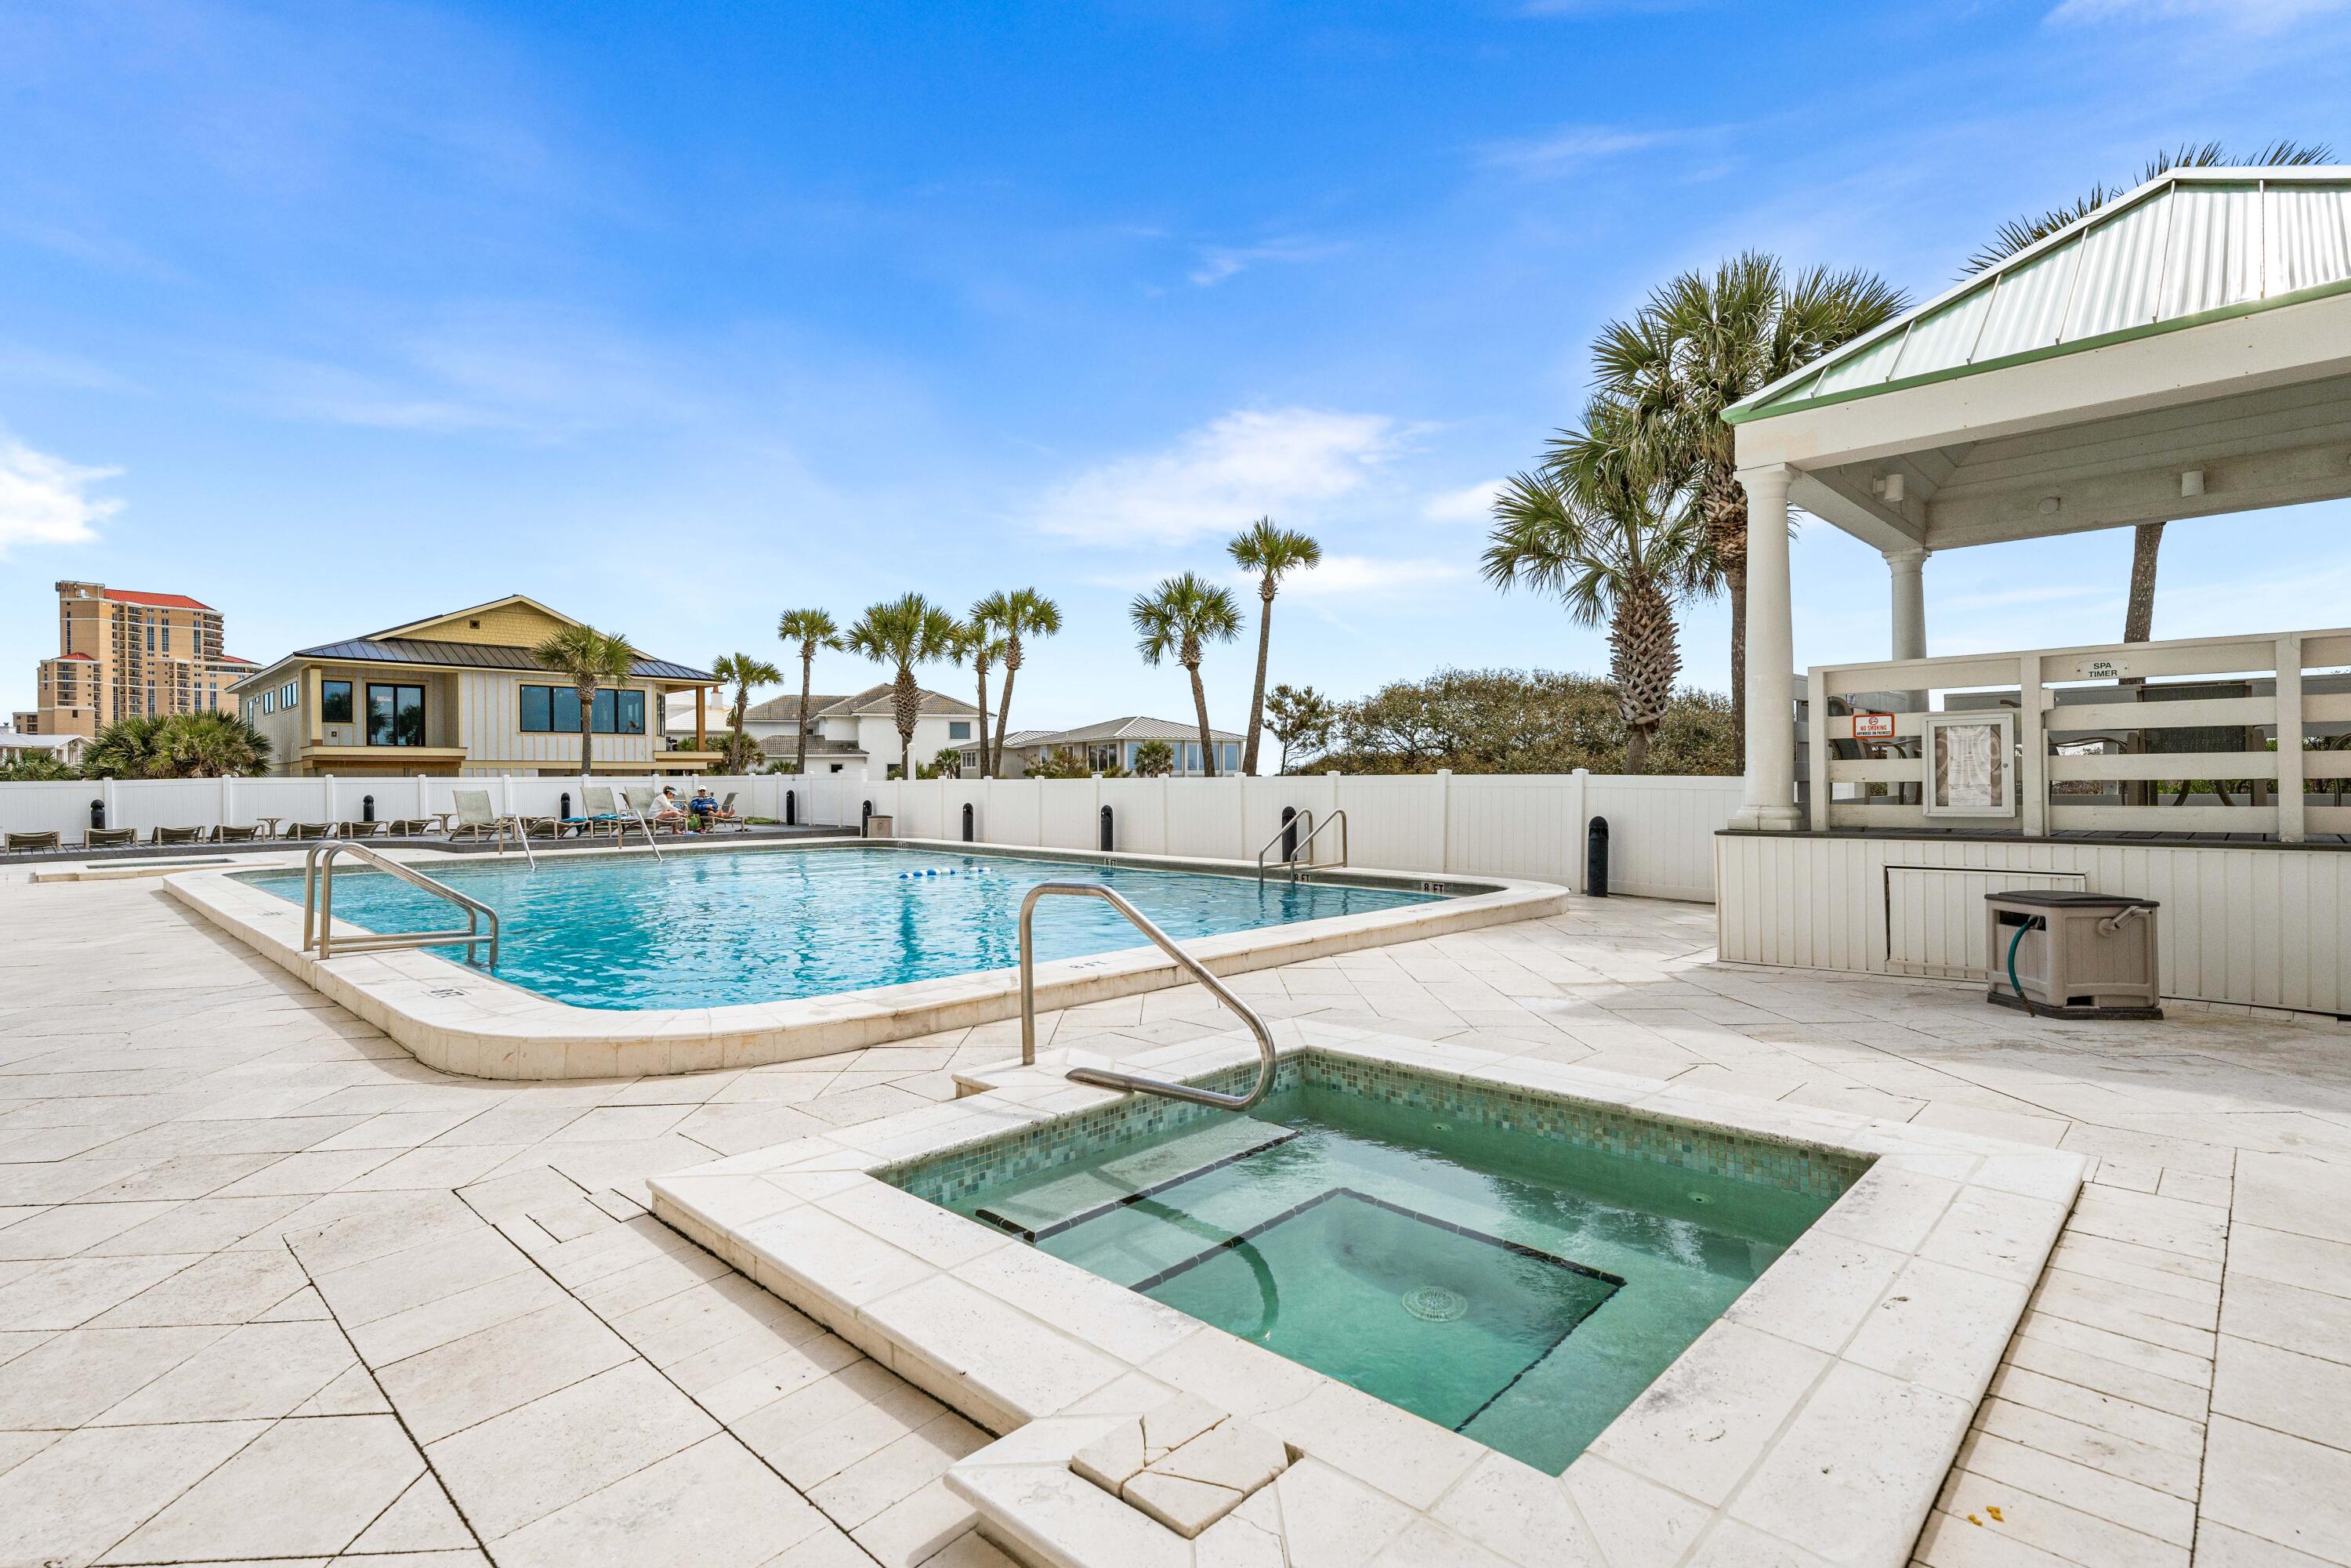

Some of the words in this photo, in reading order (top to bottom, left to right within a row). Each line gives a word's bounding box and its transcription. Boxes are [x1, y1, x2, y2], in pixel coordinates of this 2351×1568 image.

[1301, 874, 1310, 882] FT
[1424, 882, 1429, 892] 8
[1433, 883, 1444, 893] FT
